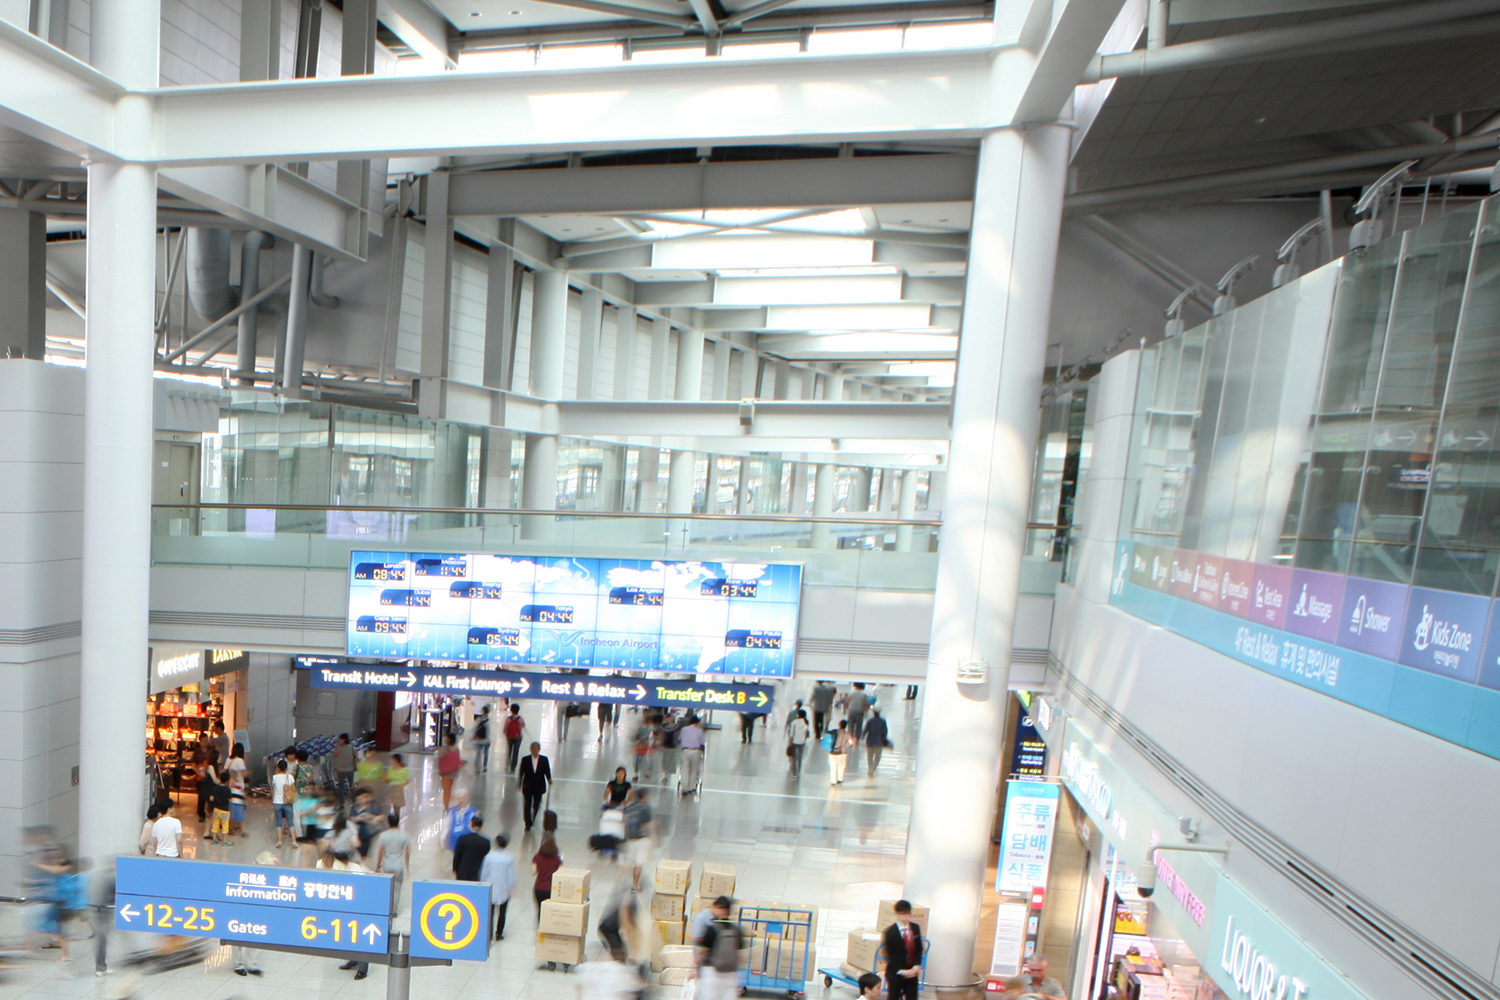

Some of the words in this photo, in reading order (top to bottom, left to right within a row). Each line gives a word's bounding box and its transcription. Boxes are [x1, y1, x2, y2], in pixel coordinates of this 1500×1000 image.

[1309, 594, 1332, 624] Massage
[1365, 607, 1391, 633] Shower
[581, 637, 619, 647] Incheon
[623, 639, 659, 650] Airport
[1431, 620, 1450, 647] Kids
[1449, 624, 1472, 652] Zone
[1306, 646, 1341, 687] 편의시설
[322, 670, 362, 685] Transit
[365, 672, 398, 685] Hotel
[424, 675, 444, 688] KAL
[446, 676, 470, 690] First
[471, 678, 511, 694] Lounge
[541, 680, 571, 695] Rest
[573, 682, 584, 696] &
[588, 683, 626, 698] Relax
[656, 687, 704, 702] Transfer
[705, 690, 735, 704] Desk
[736, 692, 746, 704] B
[1015, 802, 1051, 822] 주류
[1011, 833, 1048, 852] 담배
[1007, 862, 1043, 881] 식품
[225, 885, 297, 902] Information
[303, 882, 353, 901] 공항안내
[143, 903, 216, 931] 12-25
[228, 920, 267, 935] Gates
[301, 916, 359, 944] 6-11
